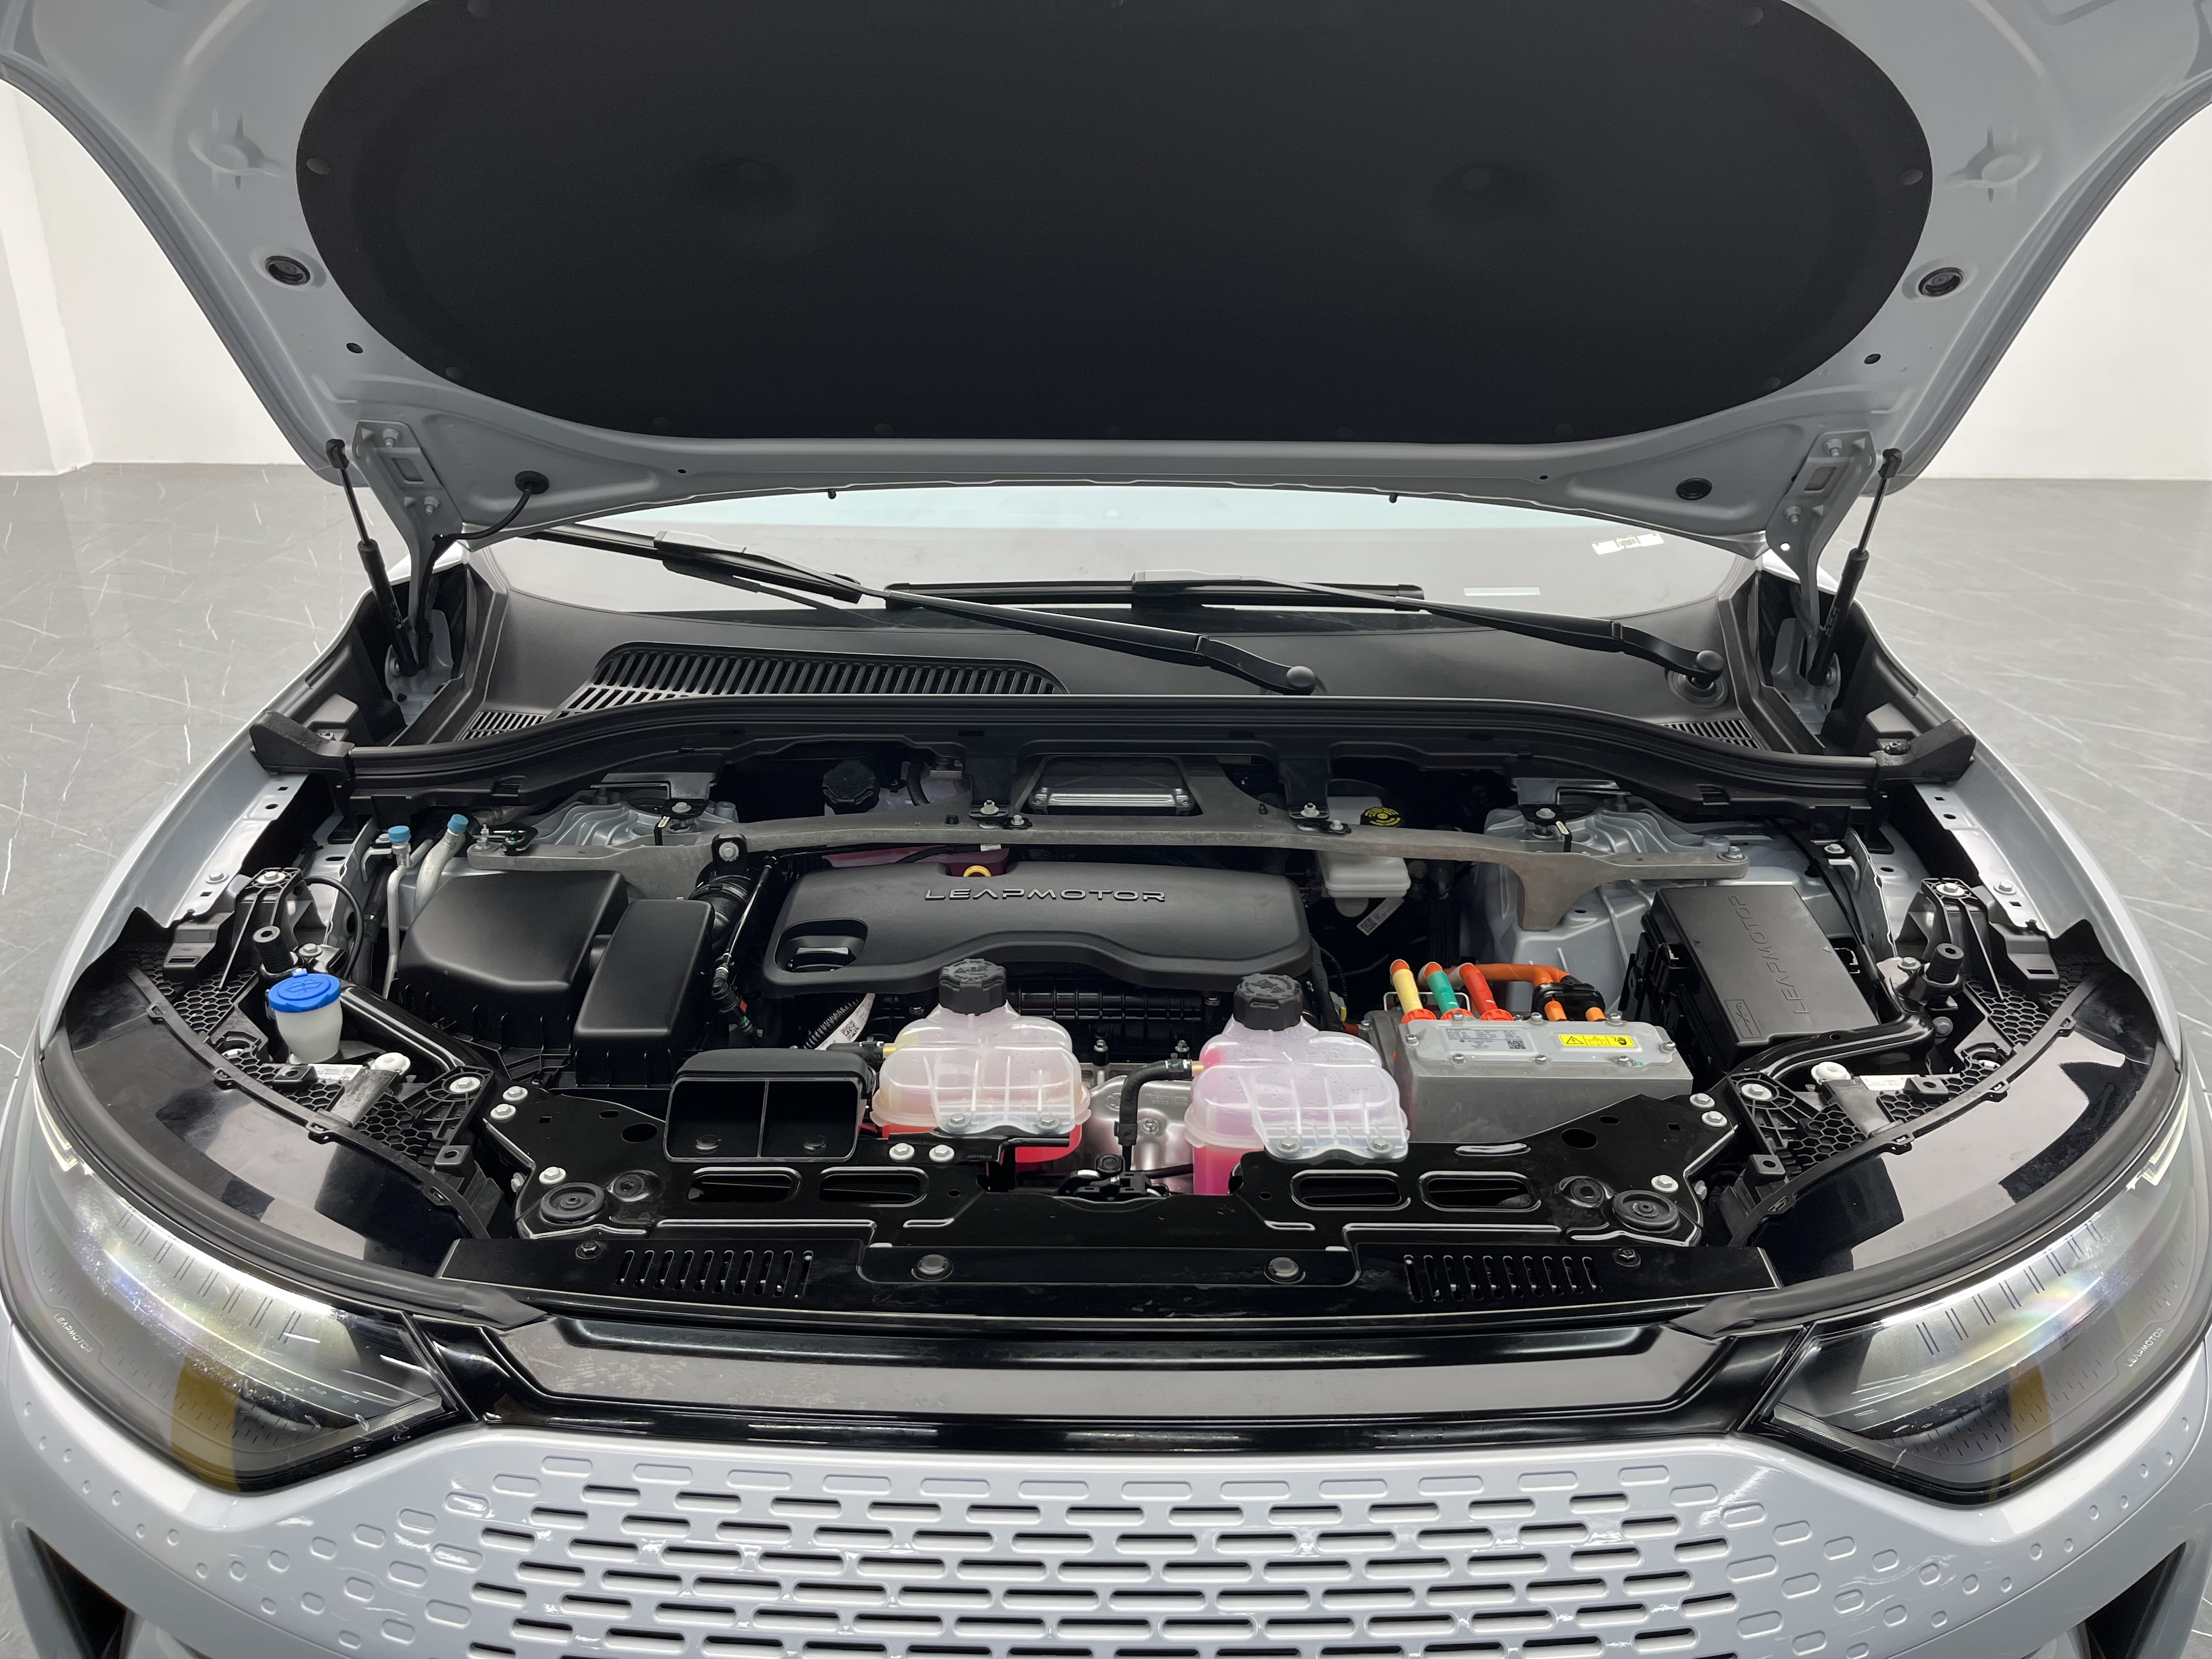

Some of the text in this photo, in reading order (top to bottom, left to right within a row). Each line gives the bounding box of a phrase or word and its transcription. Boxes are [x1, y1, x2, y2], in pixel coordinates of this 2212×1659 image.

[925, 888, 1165, 902] LEAPMOTOR
[1728, 895, 1810, 1014] LEAPMOTOR
[53, 1313, 93, 1353] LEAPMOTOR
[2124, 1327, 2165, 1367] LEAPMOTOR
